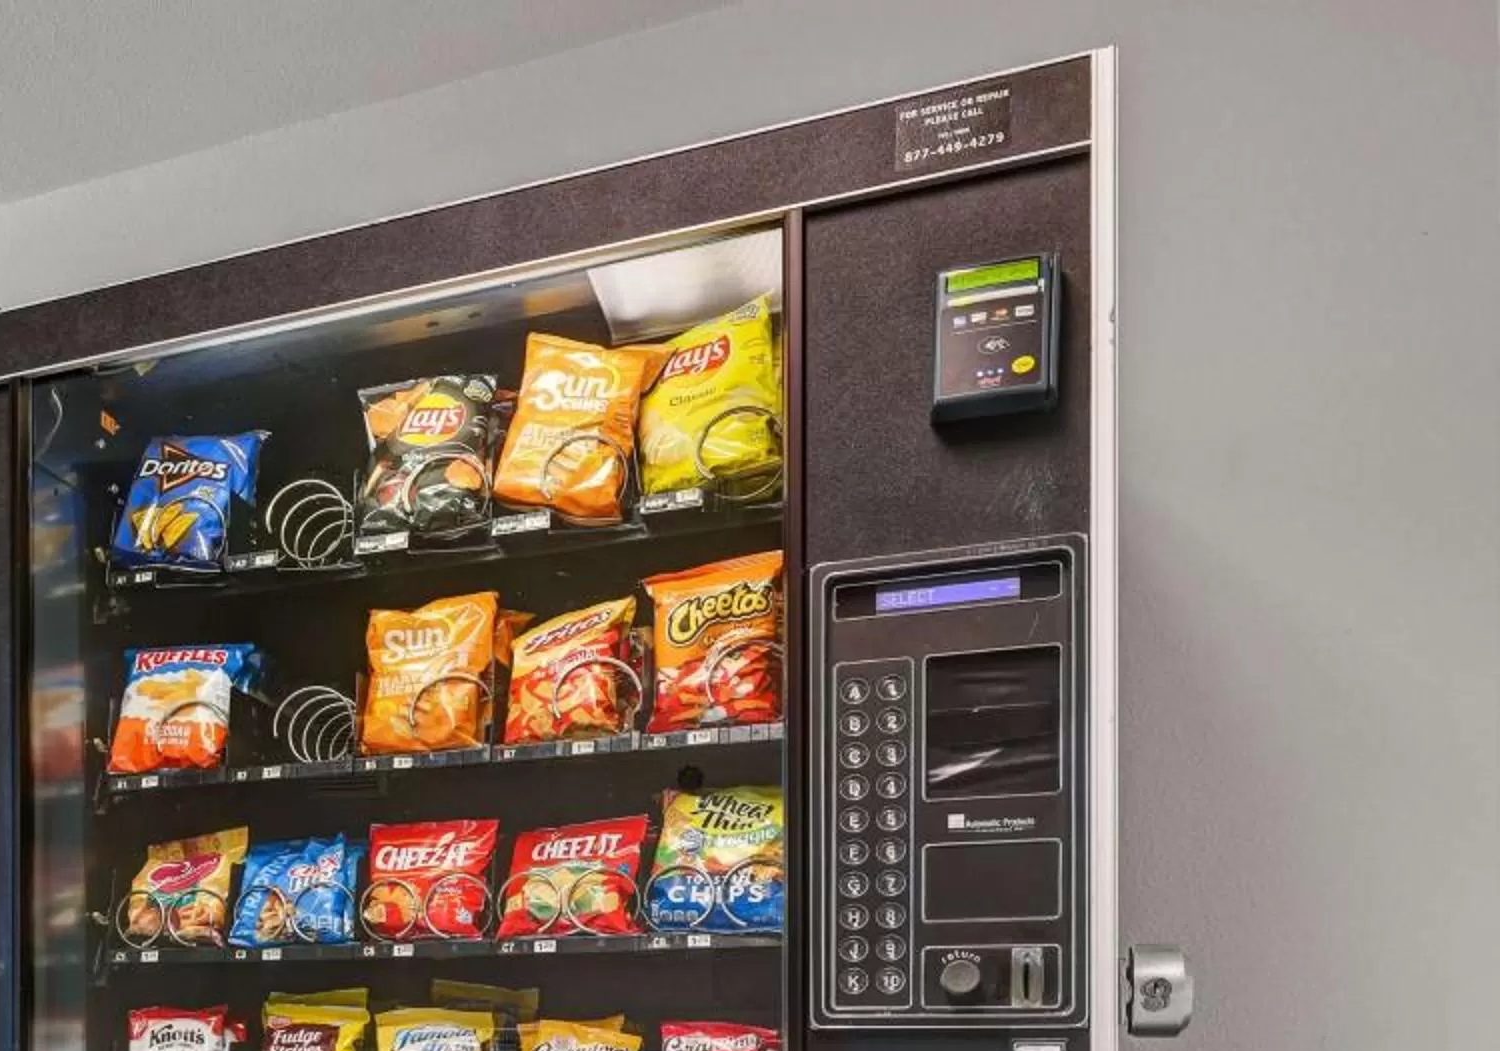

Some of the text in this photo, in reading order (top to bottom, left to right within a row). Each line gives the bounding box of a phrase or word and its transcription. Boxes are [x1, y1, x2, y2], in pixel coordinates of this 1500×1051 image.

[899, 110, 918, 120] FOR
[920, 100, 958, 116] SERVICE
[924, 107, 984, 126] PLEASE CALL
[530, 369, 614, 412] Sun
[139, 458, 229, 480] Doritos
[880, 588, 937, 608] SELECT
[668, 582, 773, 646] Cheetos
[381, 627, 450, 666] Sun
[135, 649, 229, 671] RUFFLES
[667, 884, 767, 904] CHIPS
[940, 949, 981, 964] return
[148, 1023, 206, 1049] Knott's
[271, 1029, 323, 1047] Fudge
